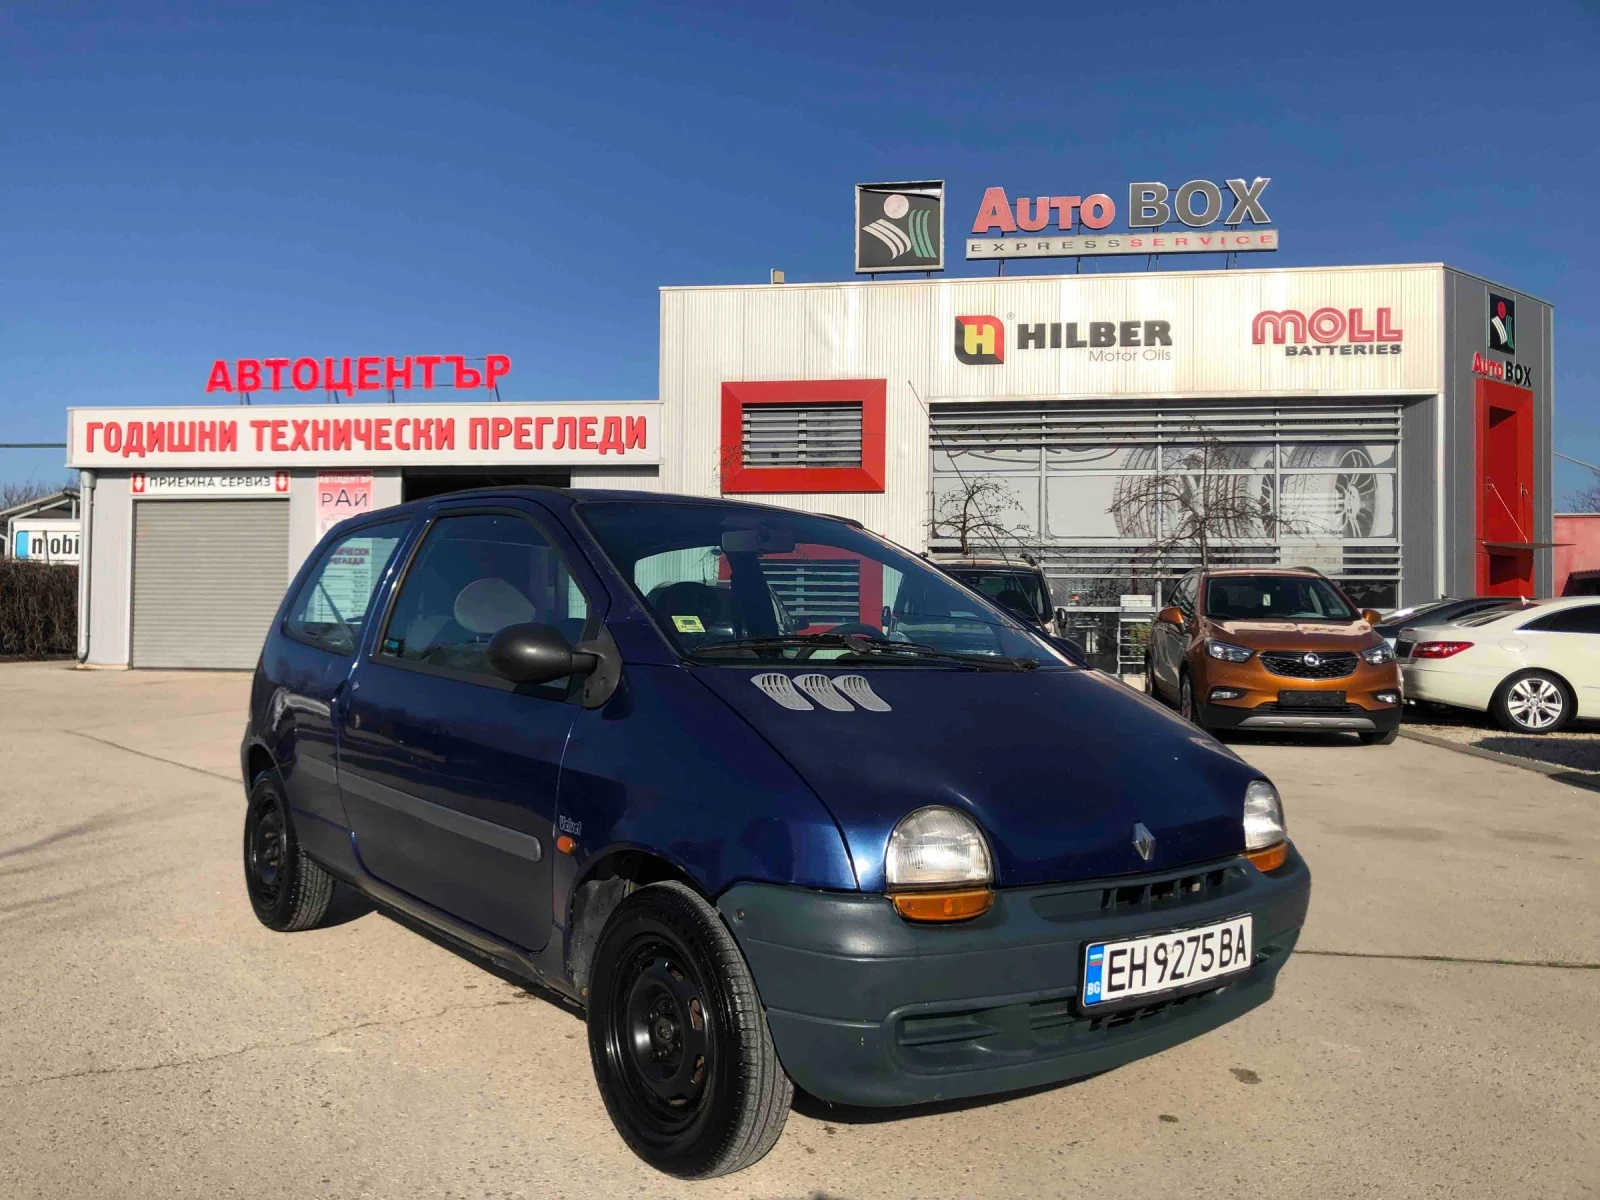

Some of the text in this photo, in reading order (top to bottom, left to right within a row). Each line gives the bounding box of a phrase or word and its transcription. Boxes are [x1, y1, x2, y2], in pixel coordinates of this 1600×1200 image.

[971, 176, 1272, 234] Auto BOX
[1017, 320, 1173, 350] HILBER
[1088, 348, 1172, 363] Motor Oils
[1285, 344, 1403, 357] BATTERIES
[205, 354, 512, 398] АВТОЦЕНТЪР
[86, 415, 646, 458] ГОДИШНИ ТЕХНИЧЕСКИ ПРЕГЛЕДИ
[149, 475, 271, 488] ПРИЕМНА СЕРВИЗ
[321, 488, 368, 507] РАЙ
[1087, 981, 1101, 996] BG
